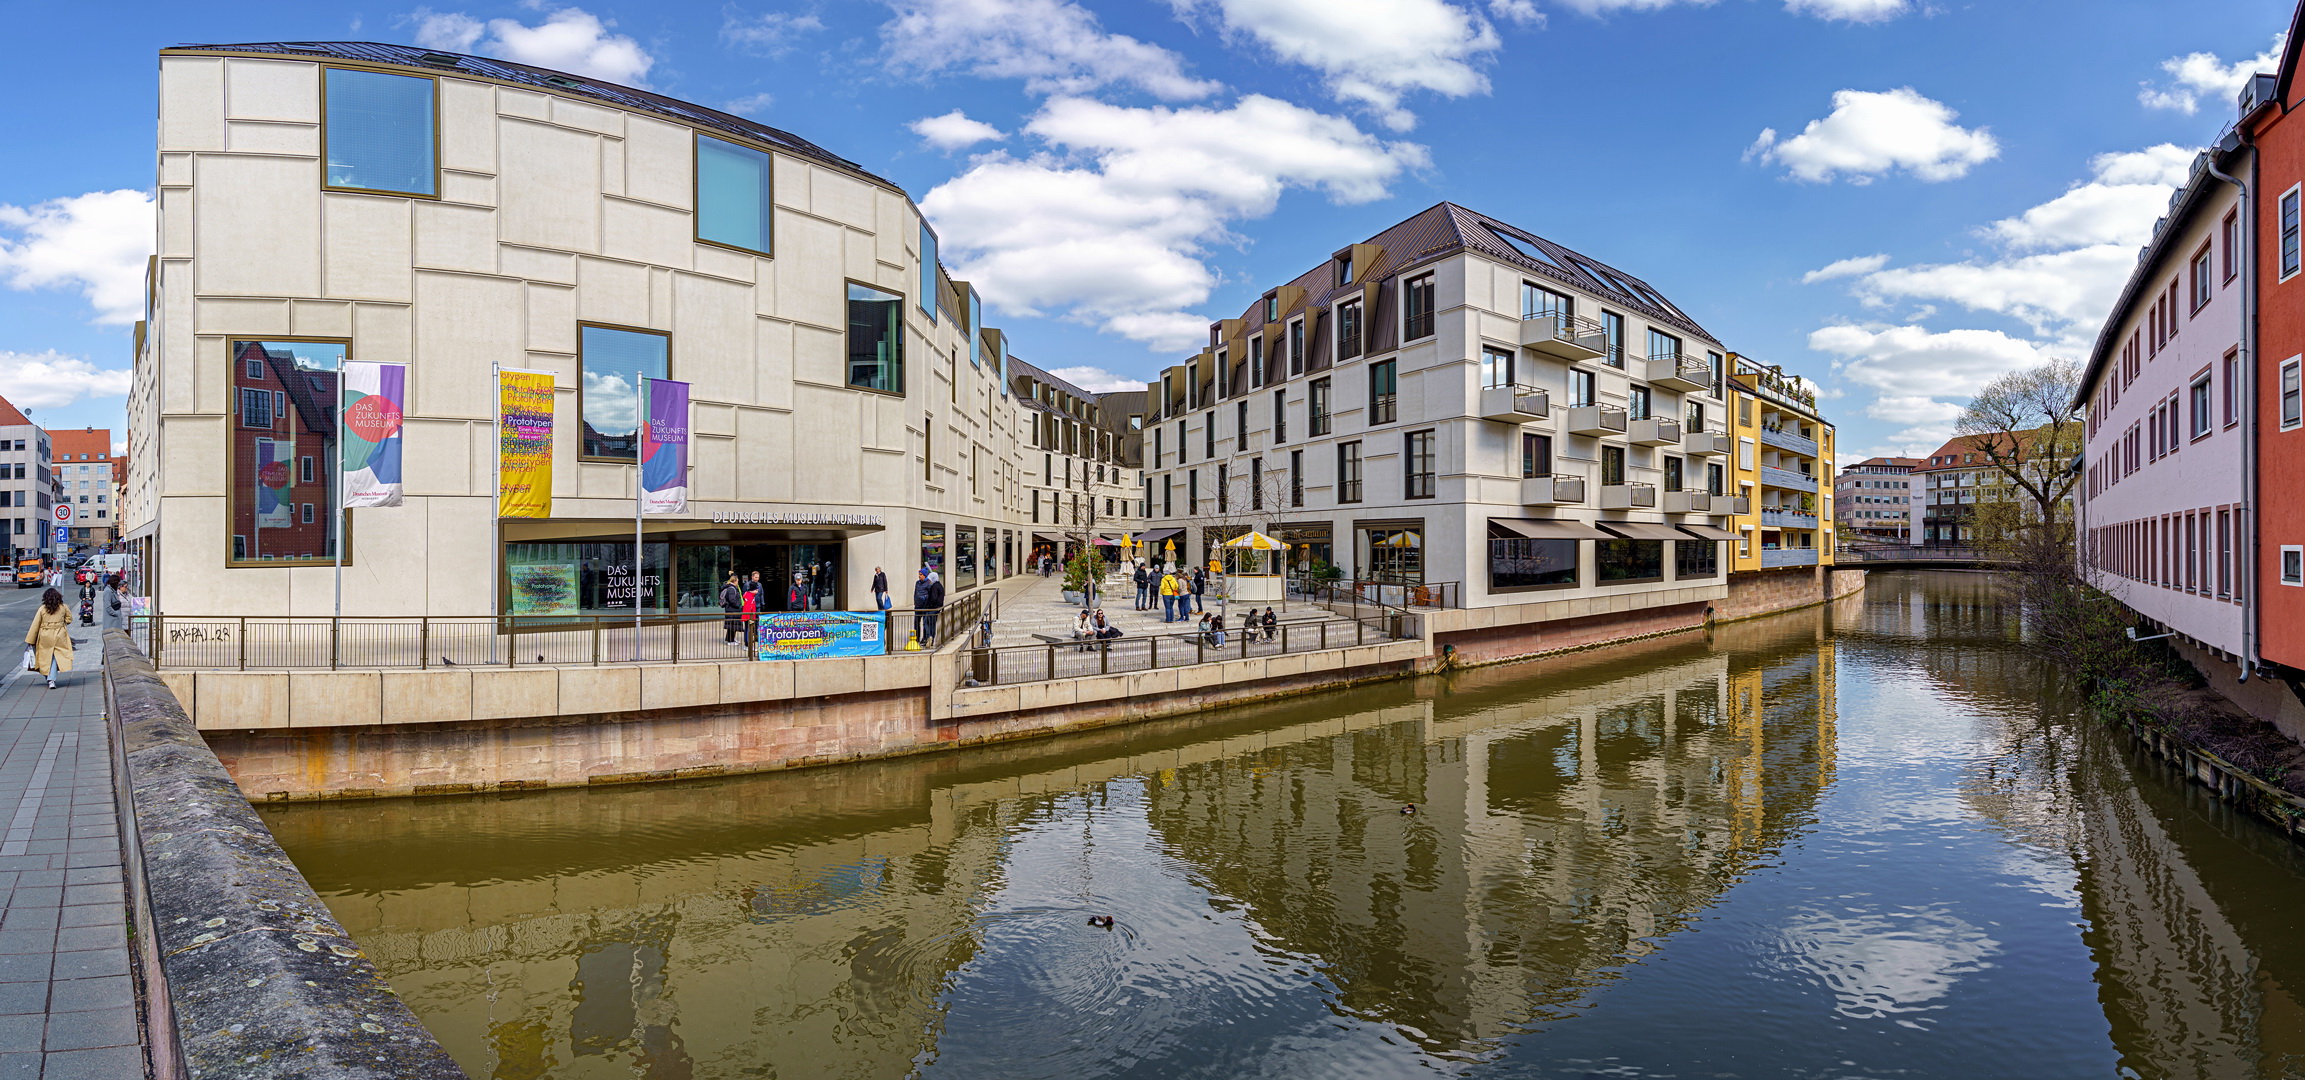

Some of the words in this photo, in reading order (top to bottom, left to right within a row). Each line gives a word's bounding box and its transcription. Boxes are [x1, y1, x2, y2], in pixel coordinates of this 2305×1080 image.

[355, 403, 373, 411] DAS
[355, 411, 401, 420] ZUKUNFTS
[355, 420, 395, 428] MUSEUM
[507, 415, 553, 428] Prototypen
[651, 418, 666, 427] DAS
[651, 426, 687, 435] ZUKUNFTS
[651, 434, 684, 442] MUSEUM
[58, 508, 68, 517] 30
[713, 511, 779, 524] DEUTSCHES
[783, 512, 829, 525] MUSEUM
[831, 513, 882, 526] NÜRNBERG
[607, 564, 628, 576] DAS
[766, 628, 822, 641] Prototypen
